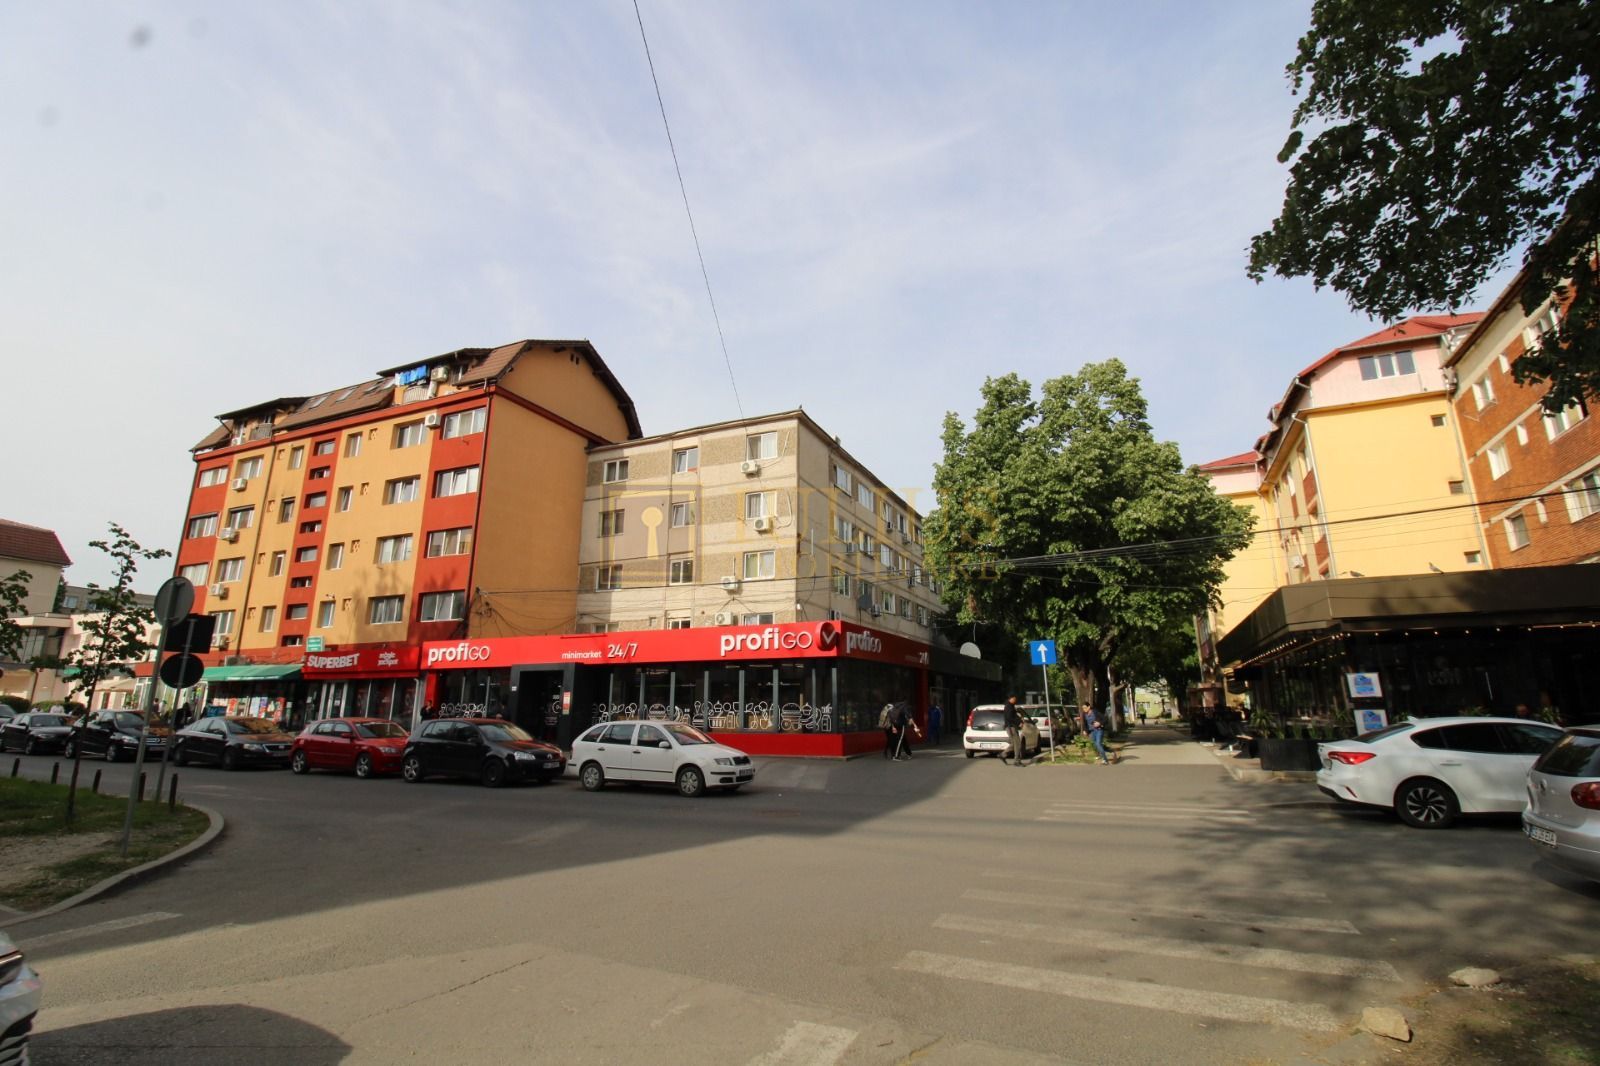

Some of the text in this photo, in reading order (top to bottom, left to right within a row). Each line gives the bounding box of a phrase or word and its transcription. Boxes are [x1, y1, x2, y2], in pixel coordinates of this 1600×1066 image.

[561, 643, 639, 660] minimarket 24/7
[720, 628, 813, 656] profiGO
[307, 653, 360, 669] SUPERBET
[427, 643, 491, 666] profiGO
